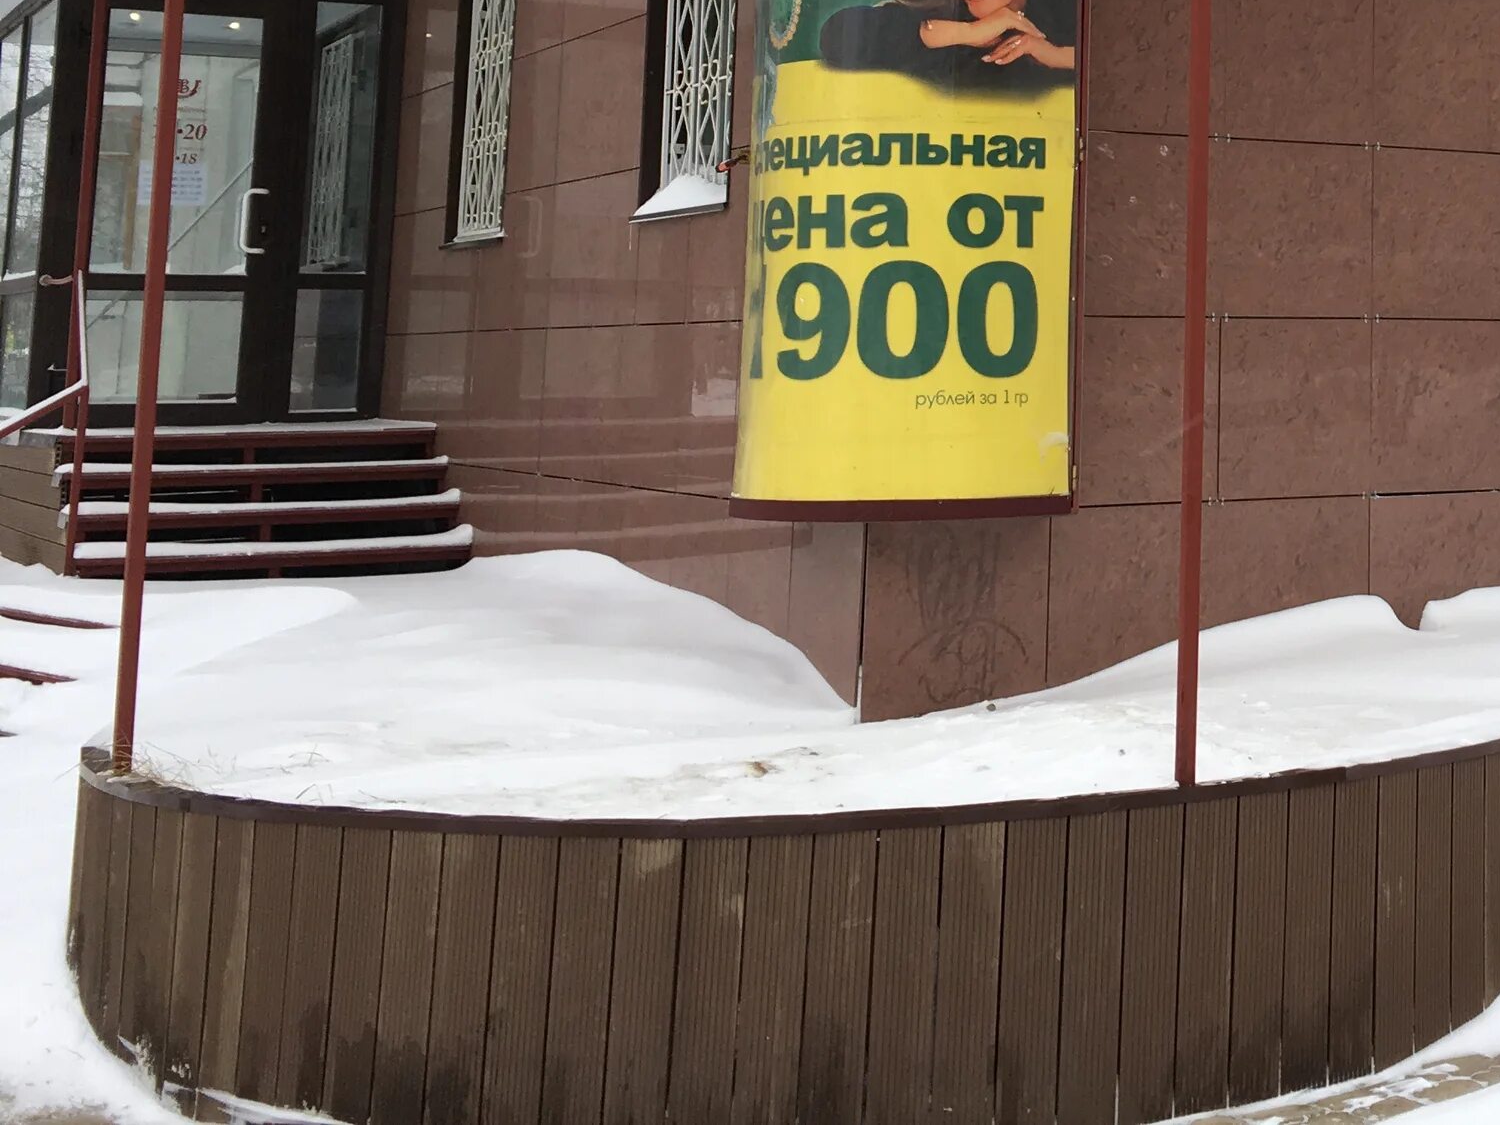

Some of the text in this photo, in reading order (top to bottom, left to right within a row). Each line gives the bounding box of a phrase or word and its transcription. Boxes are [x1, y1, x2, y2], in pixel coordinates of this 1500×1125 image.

[946, 192, 1045, 249] от
[915, 389, 1029, 410] рублей за 1 гр
